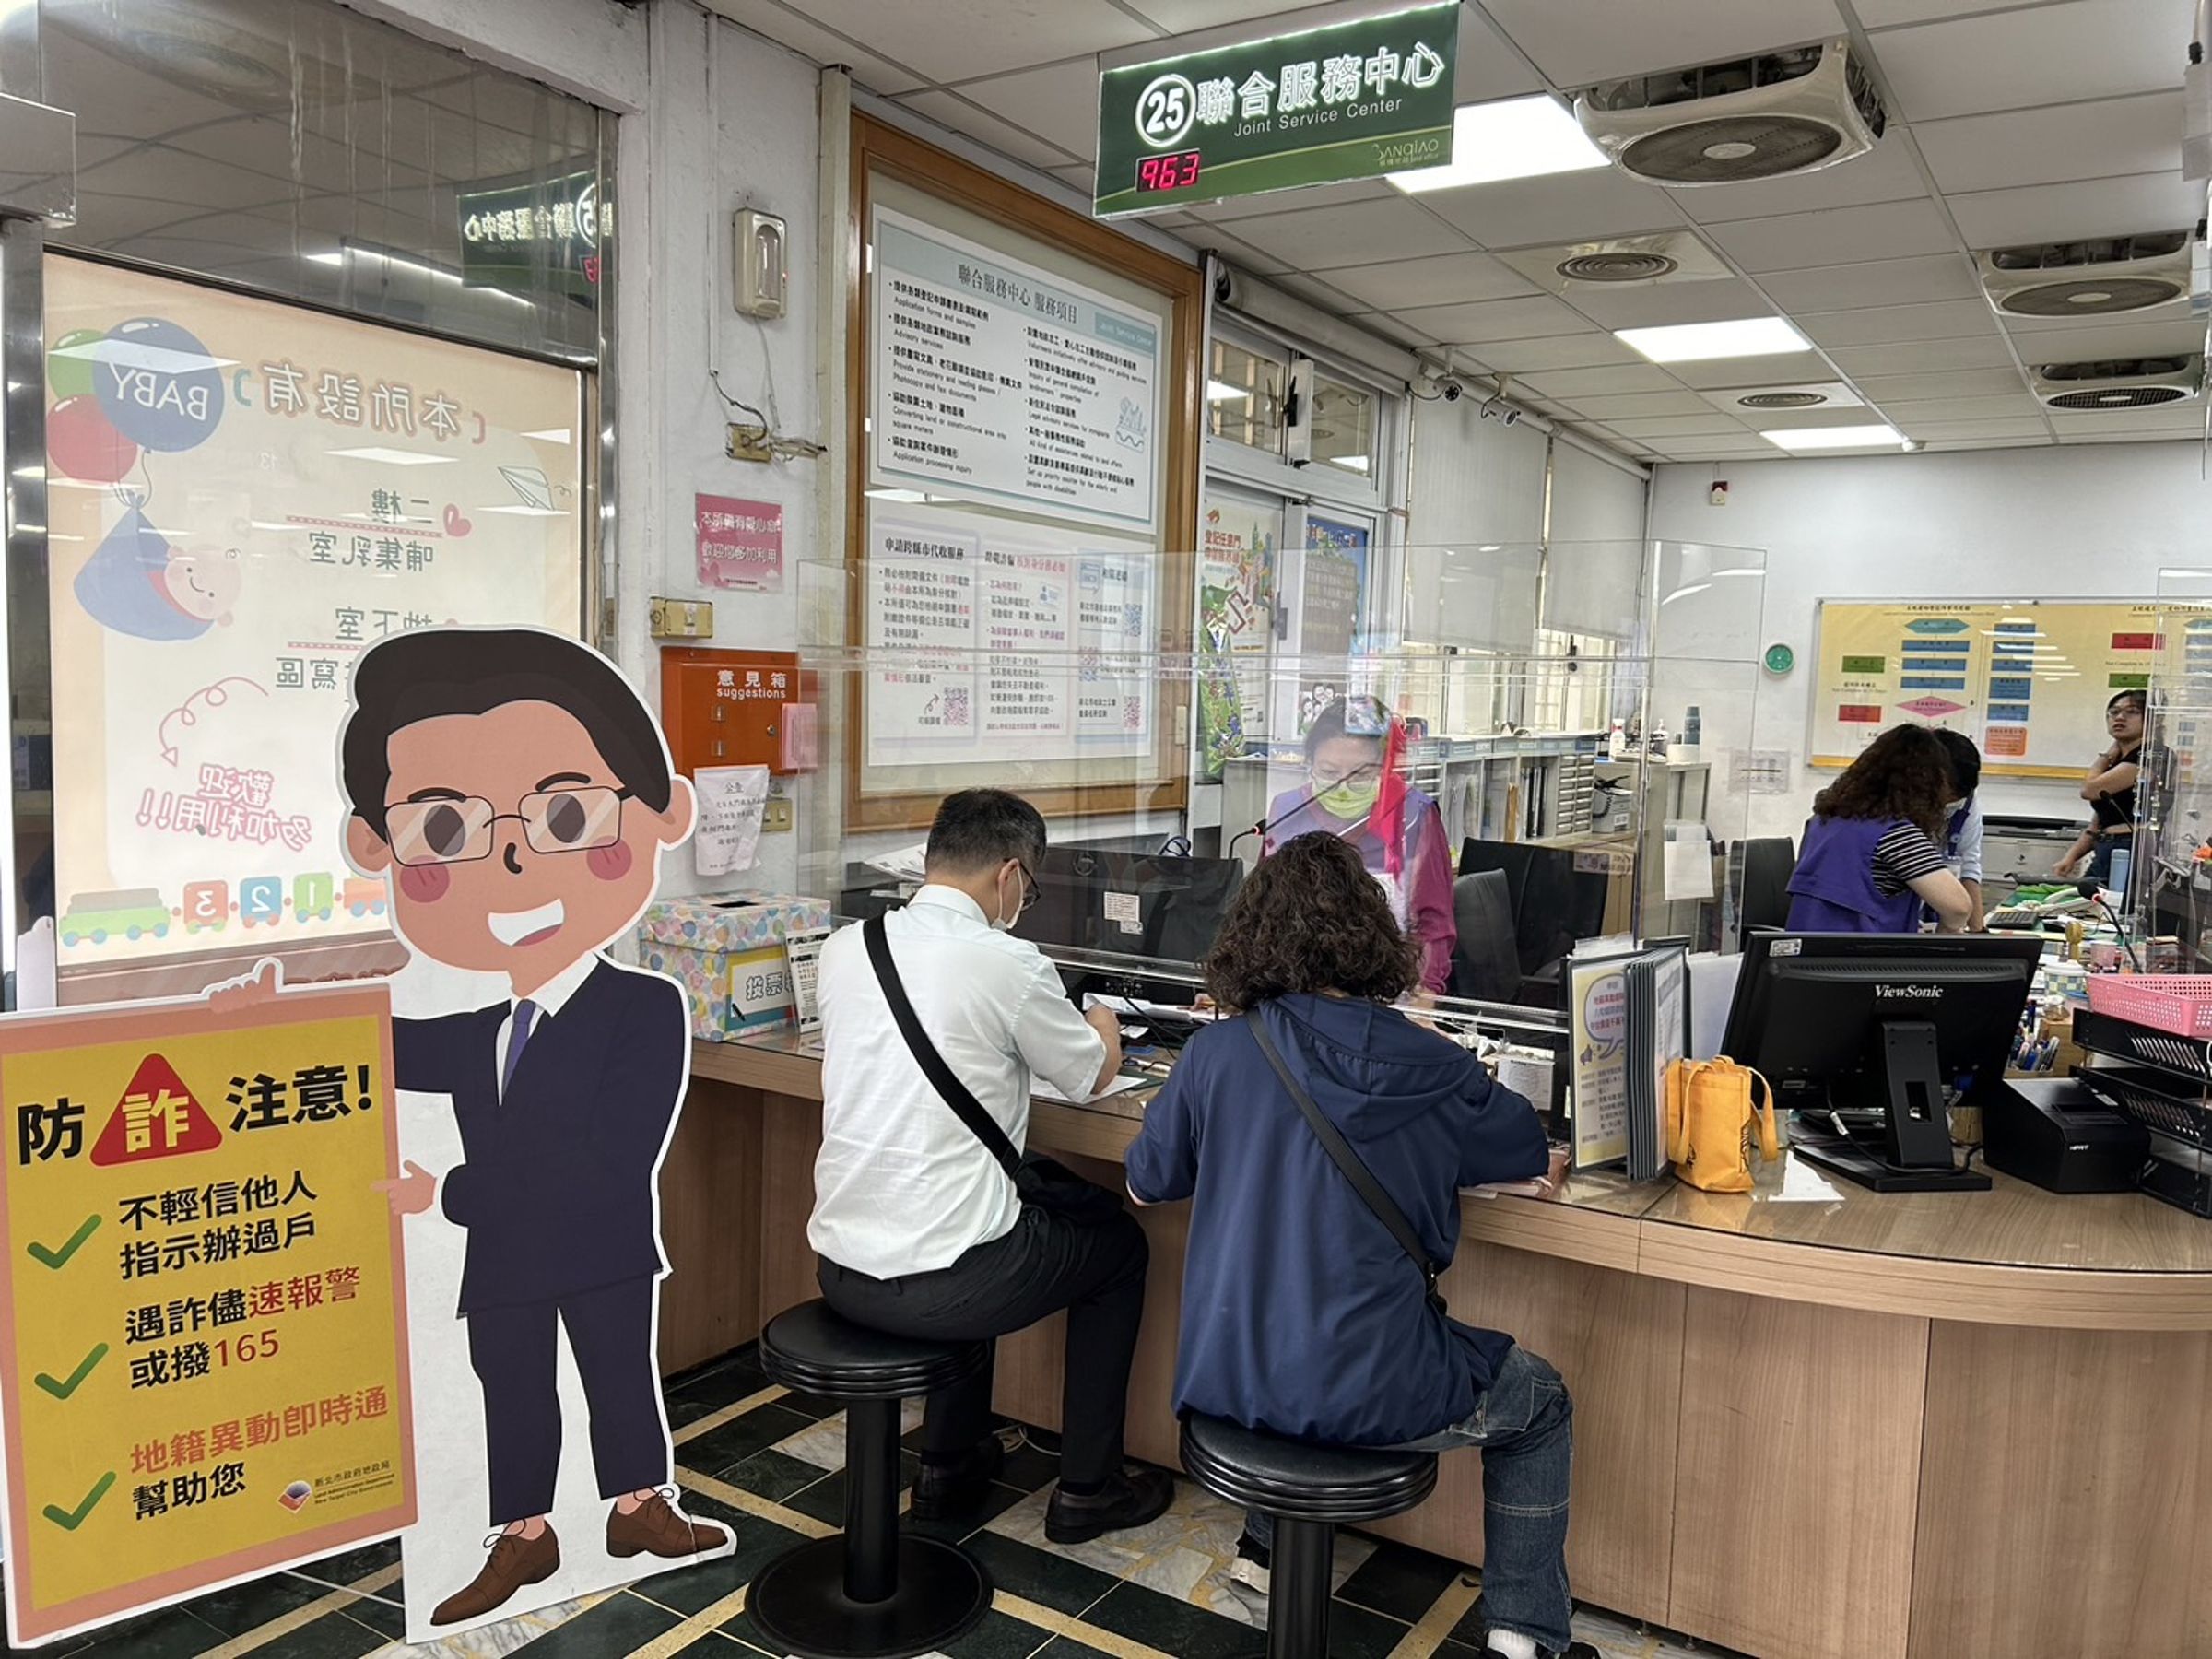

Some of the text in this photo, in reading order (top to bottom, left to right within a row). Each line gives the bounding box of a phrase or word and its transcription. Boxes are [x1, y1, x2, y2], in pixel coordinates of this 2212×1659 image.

[1147, 41, 1445, 135] 25 聯合服務中心
[1233, 98, 1403, 137] Joint Service Center
[1140, 153, 1199, 190] 963
[958, 262, 1077, 324] 聯合服務中心 服務項目
[894, 327, 918, 343] Advisory
[893, 359, 913, 373] Provide
[916, 365, 943, 382] stationery
[958, 377, 975, 390] reading
[893, 372, 923, 388] Photocopy
[892, 418, 911, 430] square
[893, 405, 923, 420] Converting
[893, 450, 924, 465] Application
[925, 457, 953, 471] processing
[717, 670, 787, 688] 意見箱
[717, 687, 786, 700] suggestions
[1875, 984, 1944, 998] ViewSonic
[225, 1065, 372, 1133] 注意!
[119, 1170, 317, 1232] 不輕信他人
[119, 1212, 316, 1280] 指示辦過戶
[125, 1266, 360, 1345] 遇詐儘速報警
[129, 1329, 280, 1390] 或撥165
[131, 1385, 388, 1474] 地籍異動即時通
[133, 1462, 246, 1521] 幫助您
